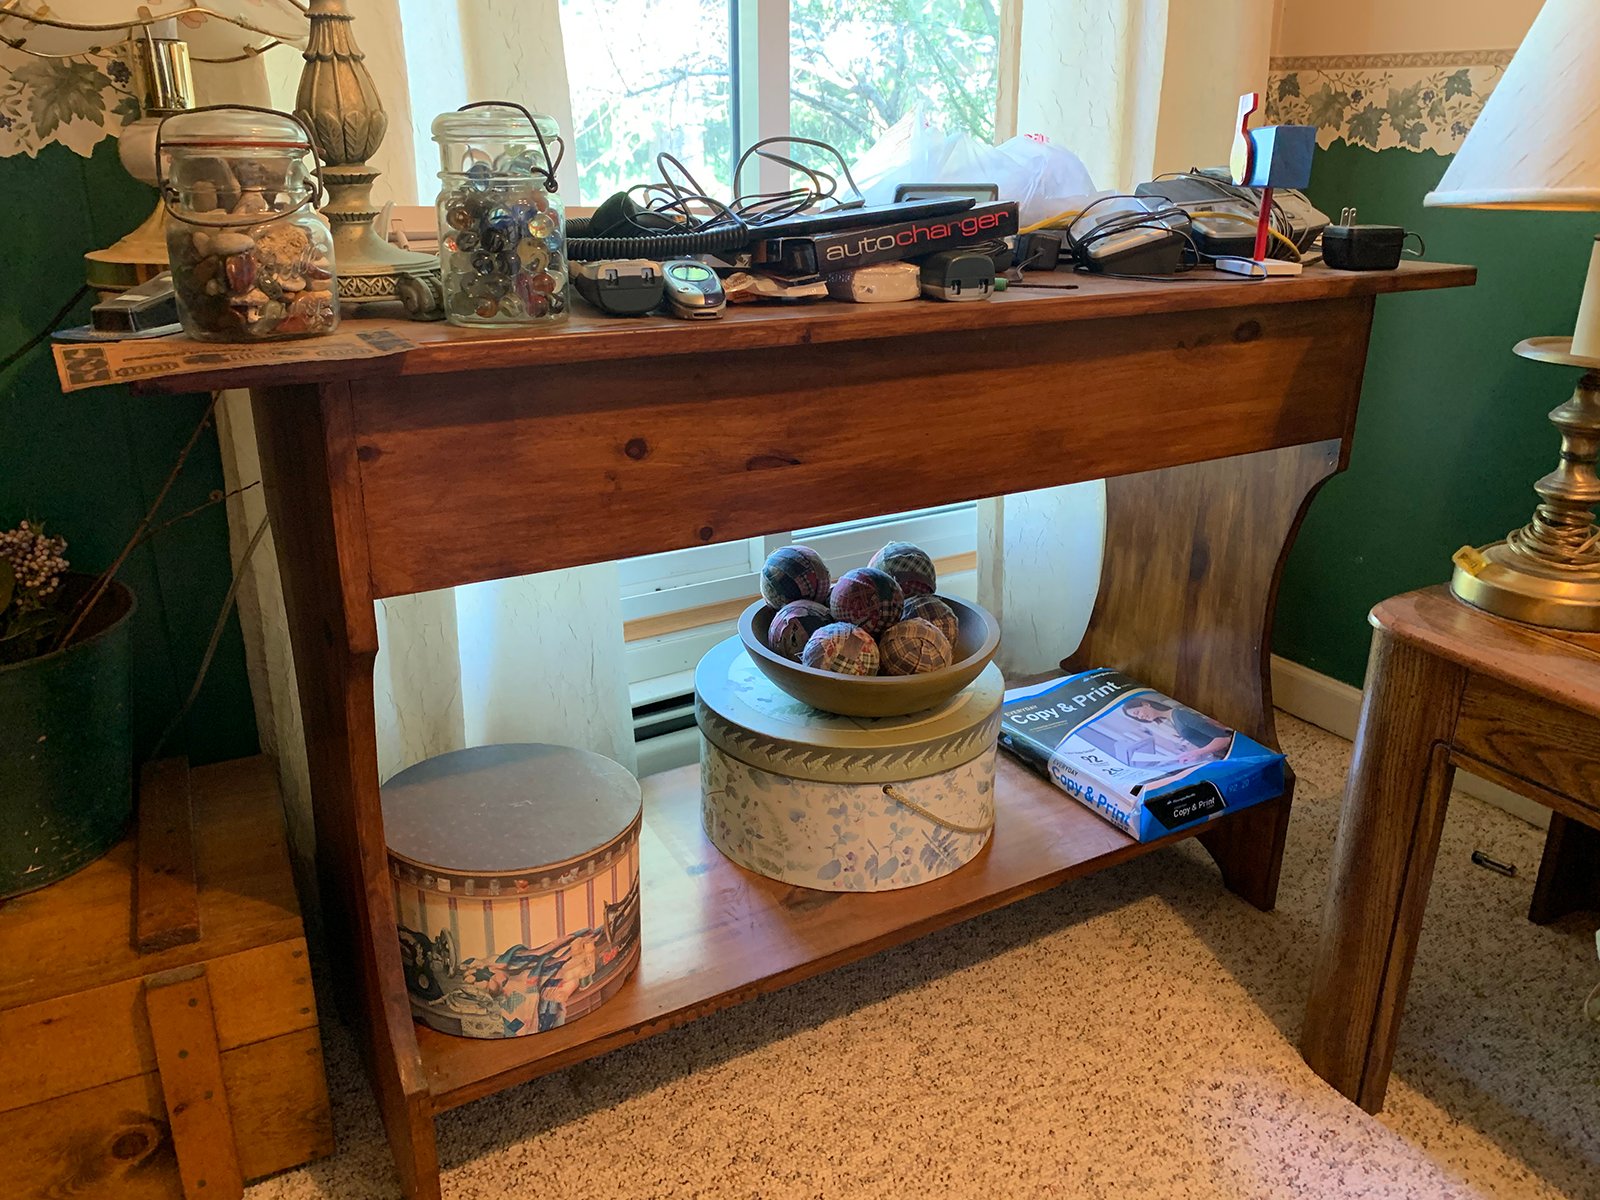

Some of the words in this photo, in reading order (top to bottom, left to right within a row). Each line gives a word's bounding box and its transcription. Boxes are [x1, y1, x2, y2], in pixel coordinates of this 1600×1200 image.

[826, 211, 1009, 262] autocharger
[1010, 708, 1060, 725] Copy
[1056, 702, 1078, 713] &
[1071, 680, 1121, 708] Print
[1053, 759, 1079, 777] EVERYDAY
[1052, 766, 1083, 797] Copy
[1084, 786, 1095, 804] &
[1096, 793, 1131, 826] Print
[1173, 806, 1191, 818] Copy
[1191, 803, 1197, 812] &
[1198, 796, 1215, 809] Print
